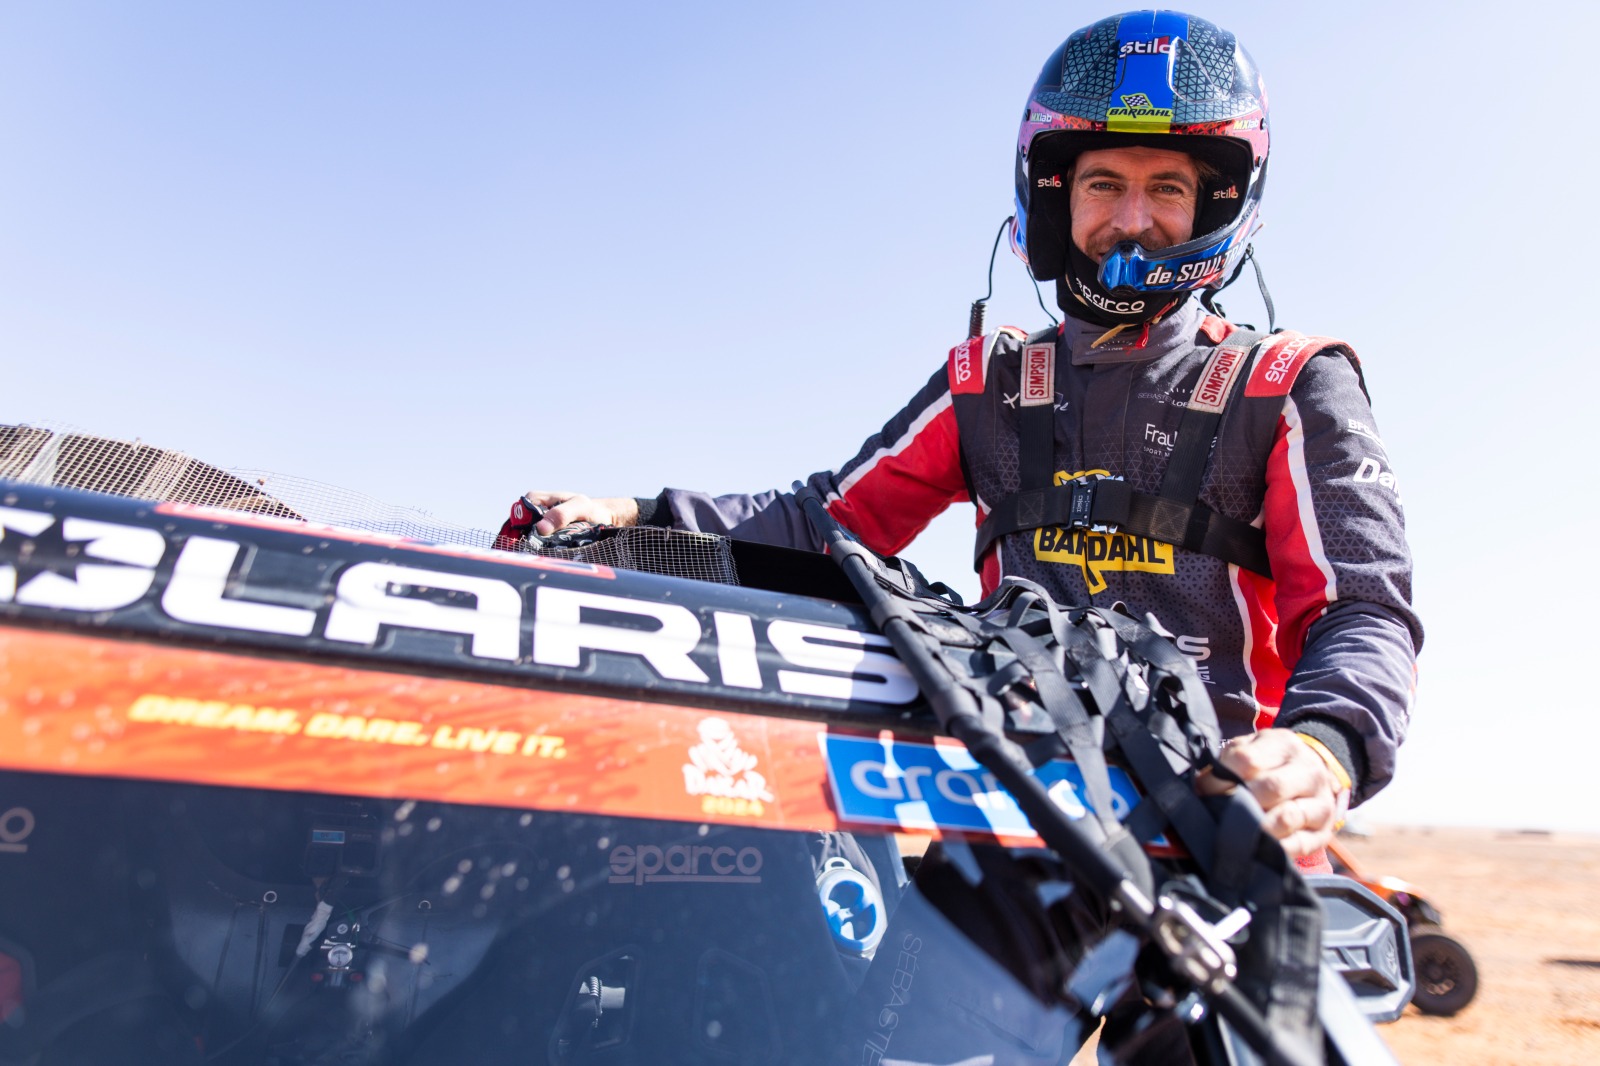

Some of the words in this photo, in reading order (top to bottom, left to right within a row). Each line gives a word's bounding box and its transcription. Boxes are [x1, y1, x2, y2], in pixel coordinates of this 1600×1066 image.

[1109, 107, 1171, 119] BARDAHL
[1037, 175, 1062, 188] stilo
[1212, 186, 1239, 199] stilo
[1146, 266, 1172, 285] de
[1029, 350, 1046, 397] SIMPSON
[1201, 351, 1237, 404] SIMPSON
[1038, 526, 1166, 580] BARDAHL
[432, 725, 521, 754] LIVE
[608, 845, 764, 886] sparco
